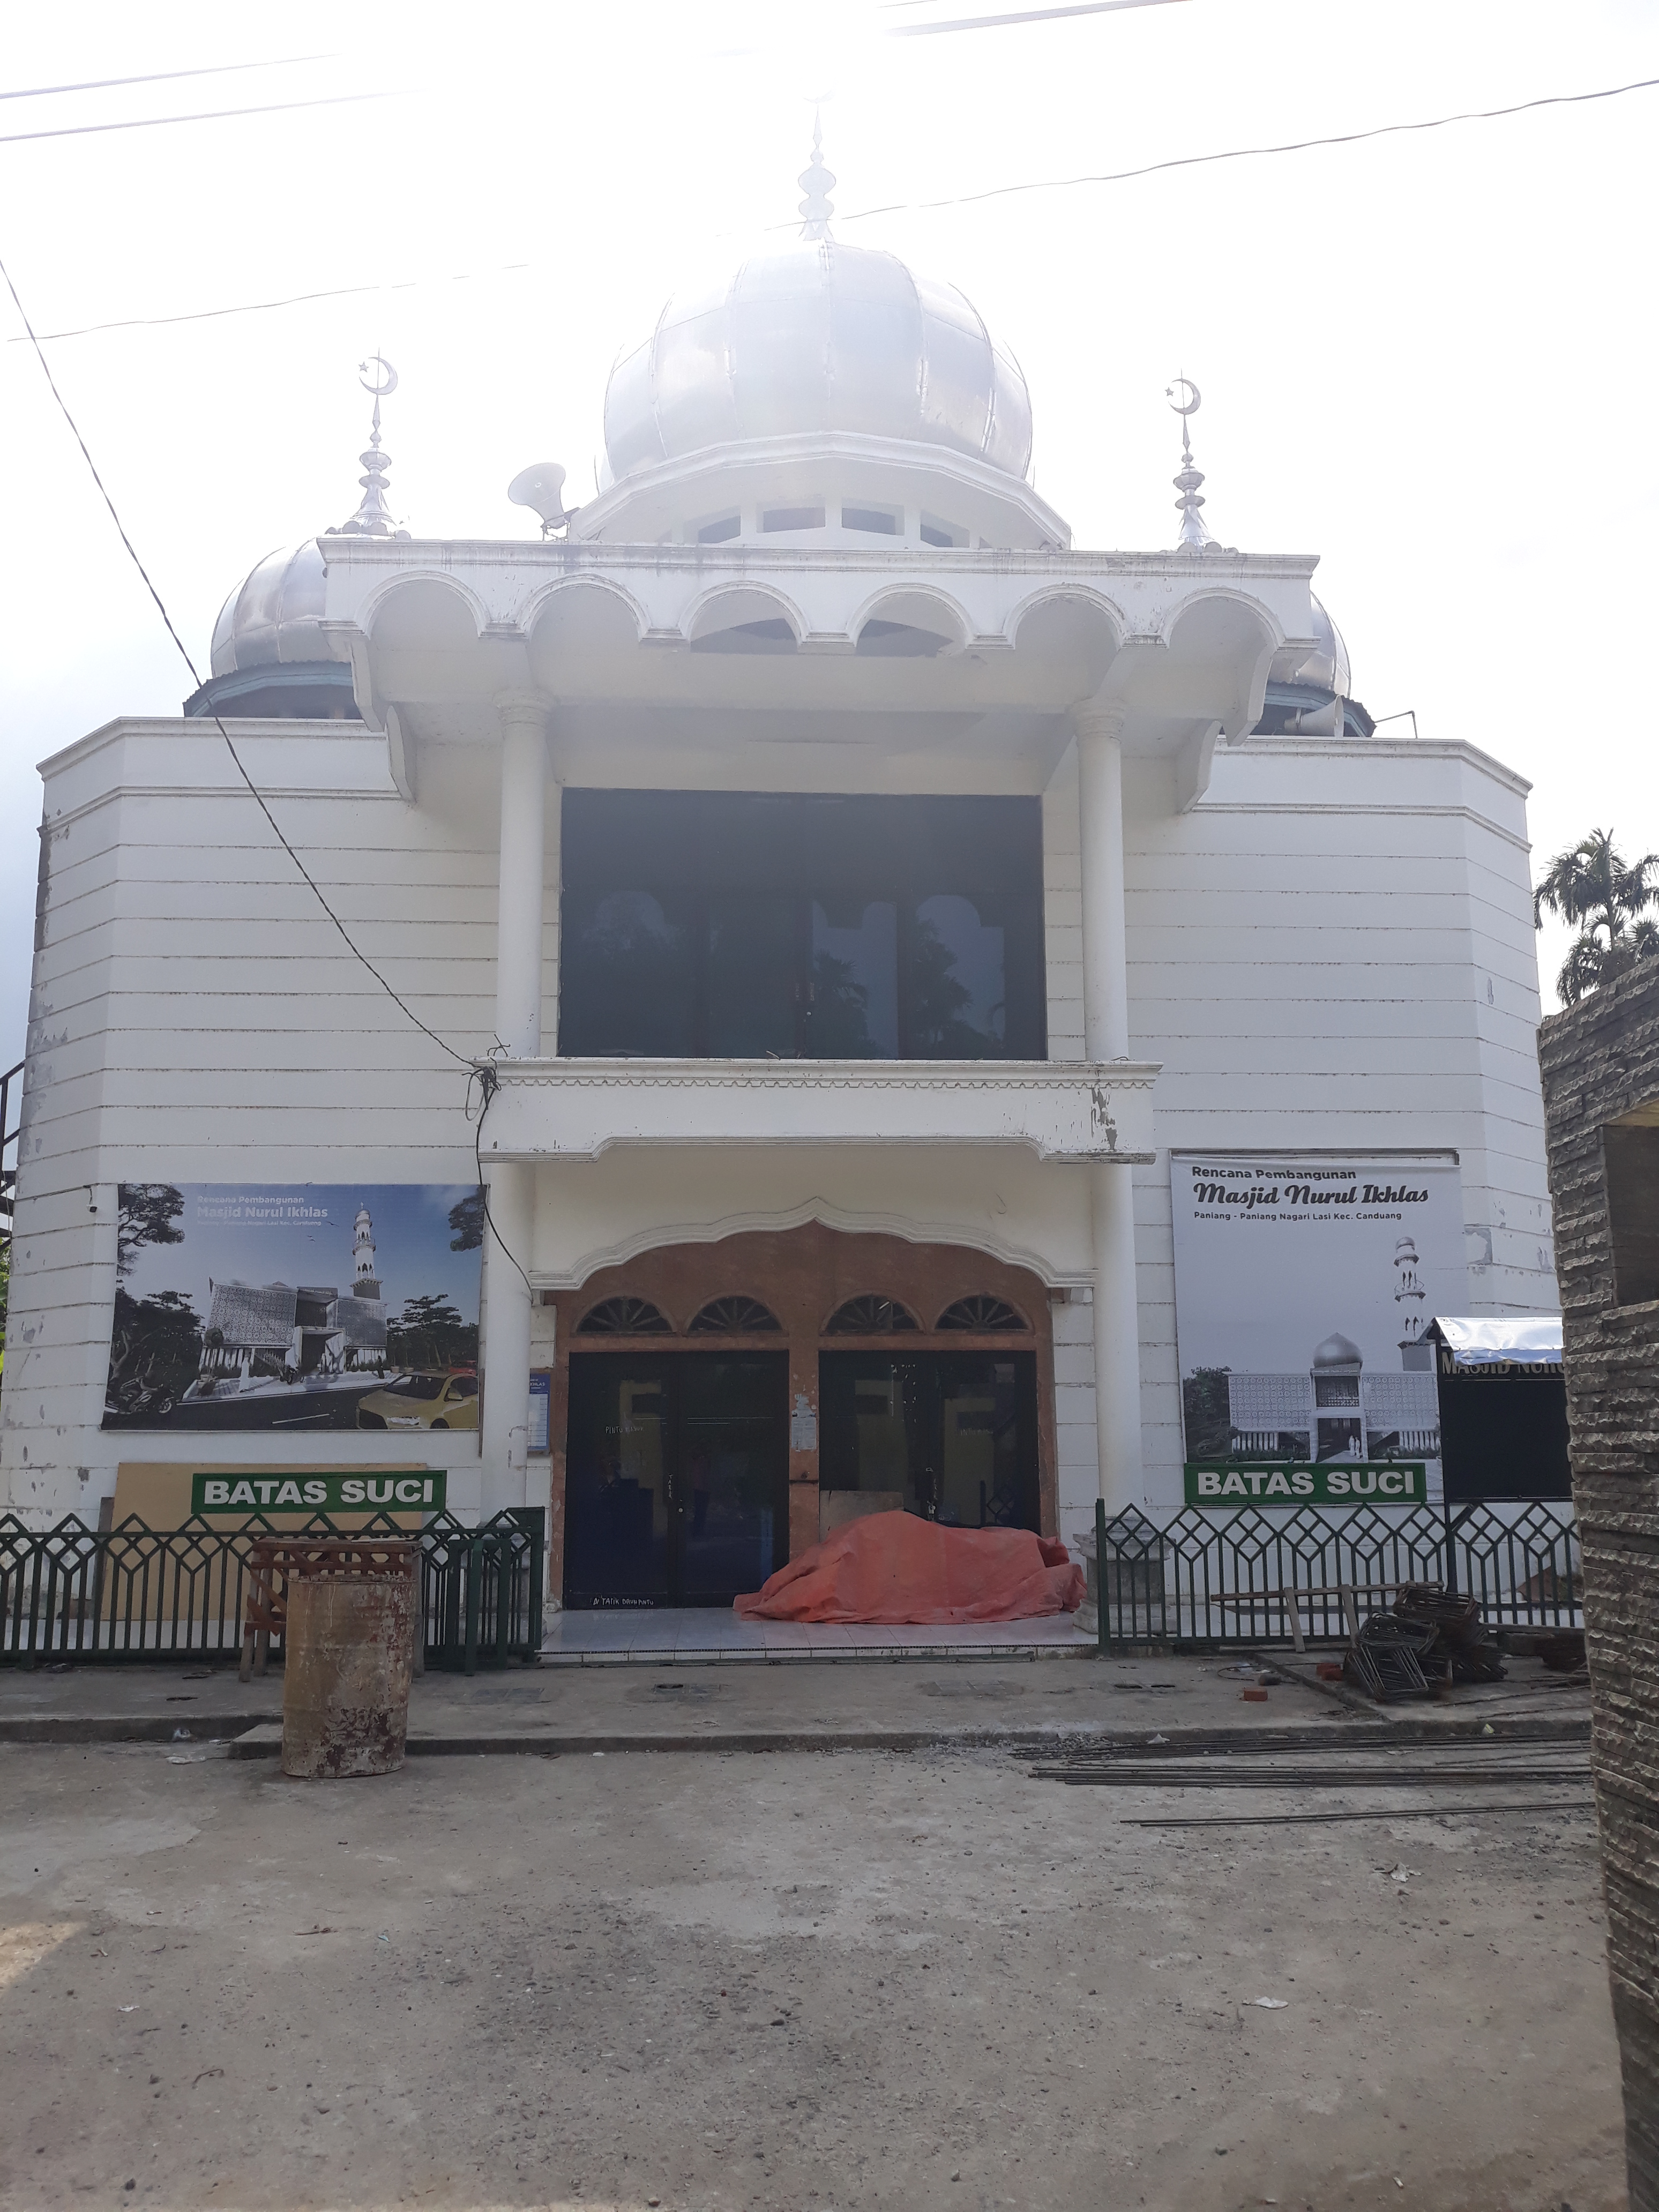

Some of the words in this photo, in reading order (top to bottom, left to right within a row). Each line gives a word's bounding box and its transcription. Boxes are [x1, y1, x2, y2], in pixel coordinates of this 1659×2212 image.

[1192, 1166, 1252, 1178] Rencana
[1256, 1169, 1356, 1180] Pembangunan
[238, 1197, 304, 1205] Pembangunan
[1193, 1183, 1280, 1209] Masjid
[1284, 1185, 1357, 1204] Nurul
[1361, 1184, 1429, 1203] Ikhlas
[197, 1206, 241, 1219] Masjid
[245, 1206, 283, 1217] Nurul
[287, 1206, 328, 1217] Ikhlas
[1194, 1212, 1231, 1221] Paniang
[1240, 1213, 1276, 1221] Paniang
[1356, 1212, 1402, 1220] Canduang
[1198, 1472, 1314, 1495] BATAS
[1327, 1471, 1414, 1494] SUCI
[204, 1480, 327, 1504] BATAS
[340, 1479, 433, 1503] SUCI
